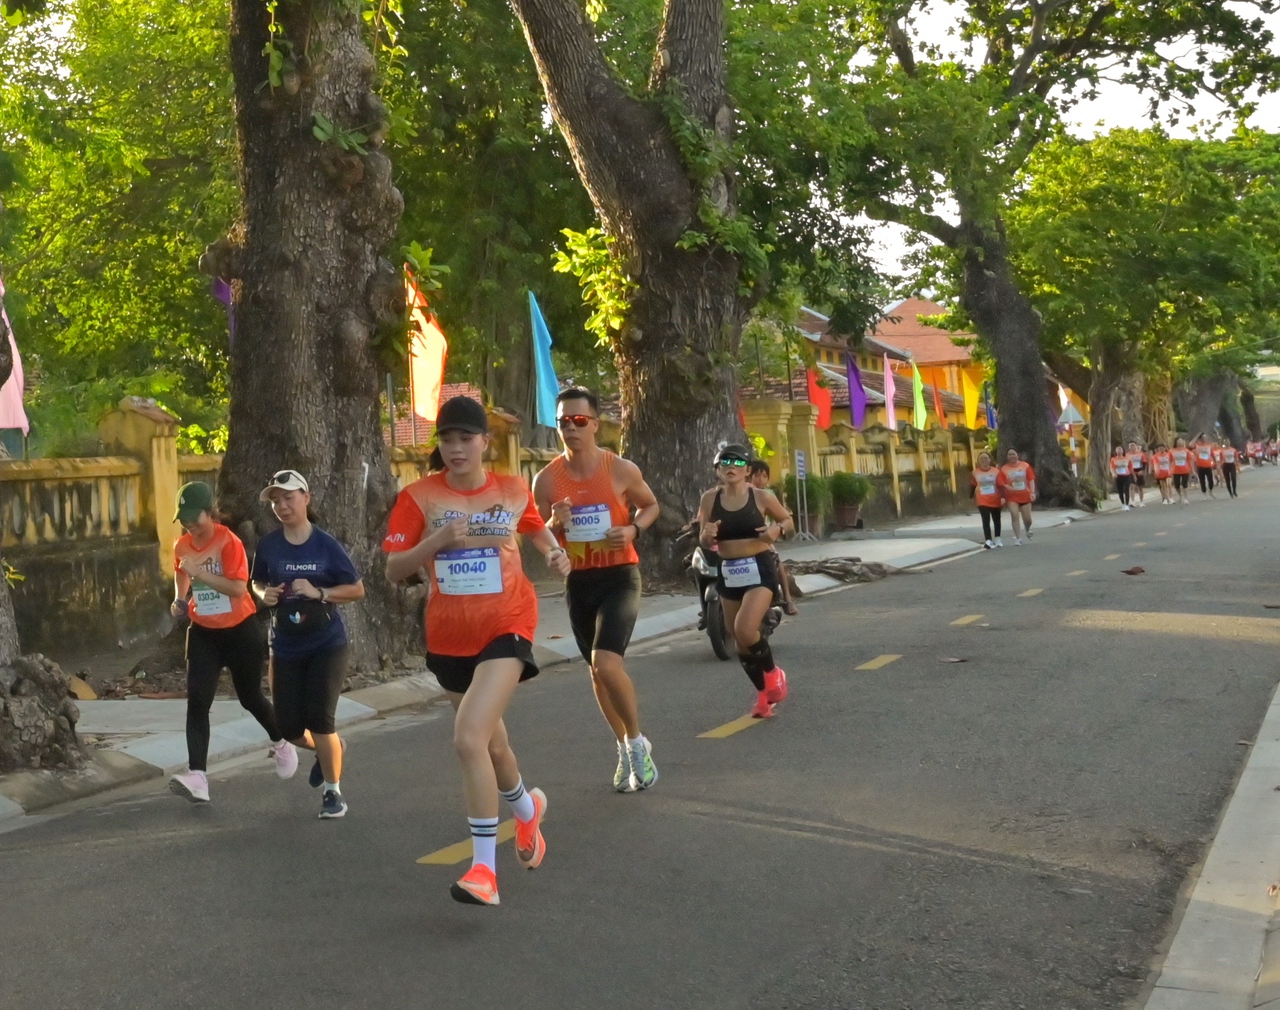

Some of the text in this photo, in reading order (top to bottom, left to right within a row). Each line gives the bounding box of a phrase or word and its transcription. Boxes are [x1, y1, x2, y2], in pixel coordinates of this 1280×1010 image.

[470, 509, 514, 525] RUN
[570, 515, 600, 526] 10005
[484, 548, 493, 556] 10
[448, 561, 487, 575] 10040
[728, 567, 750, 576] 10006
[198, 592, 220, 601] 03034
